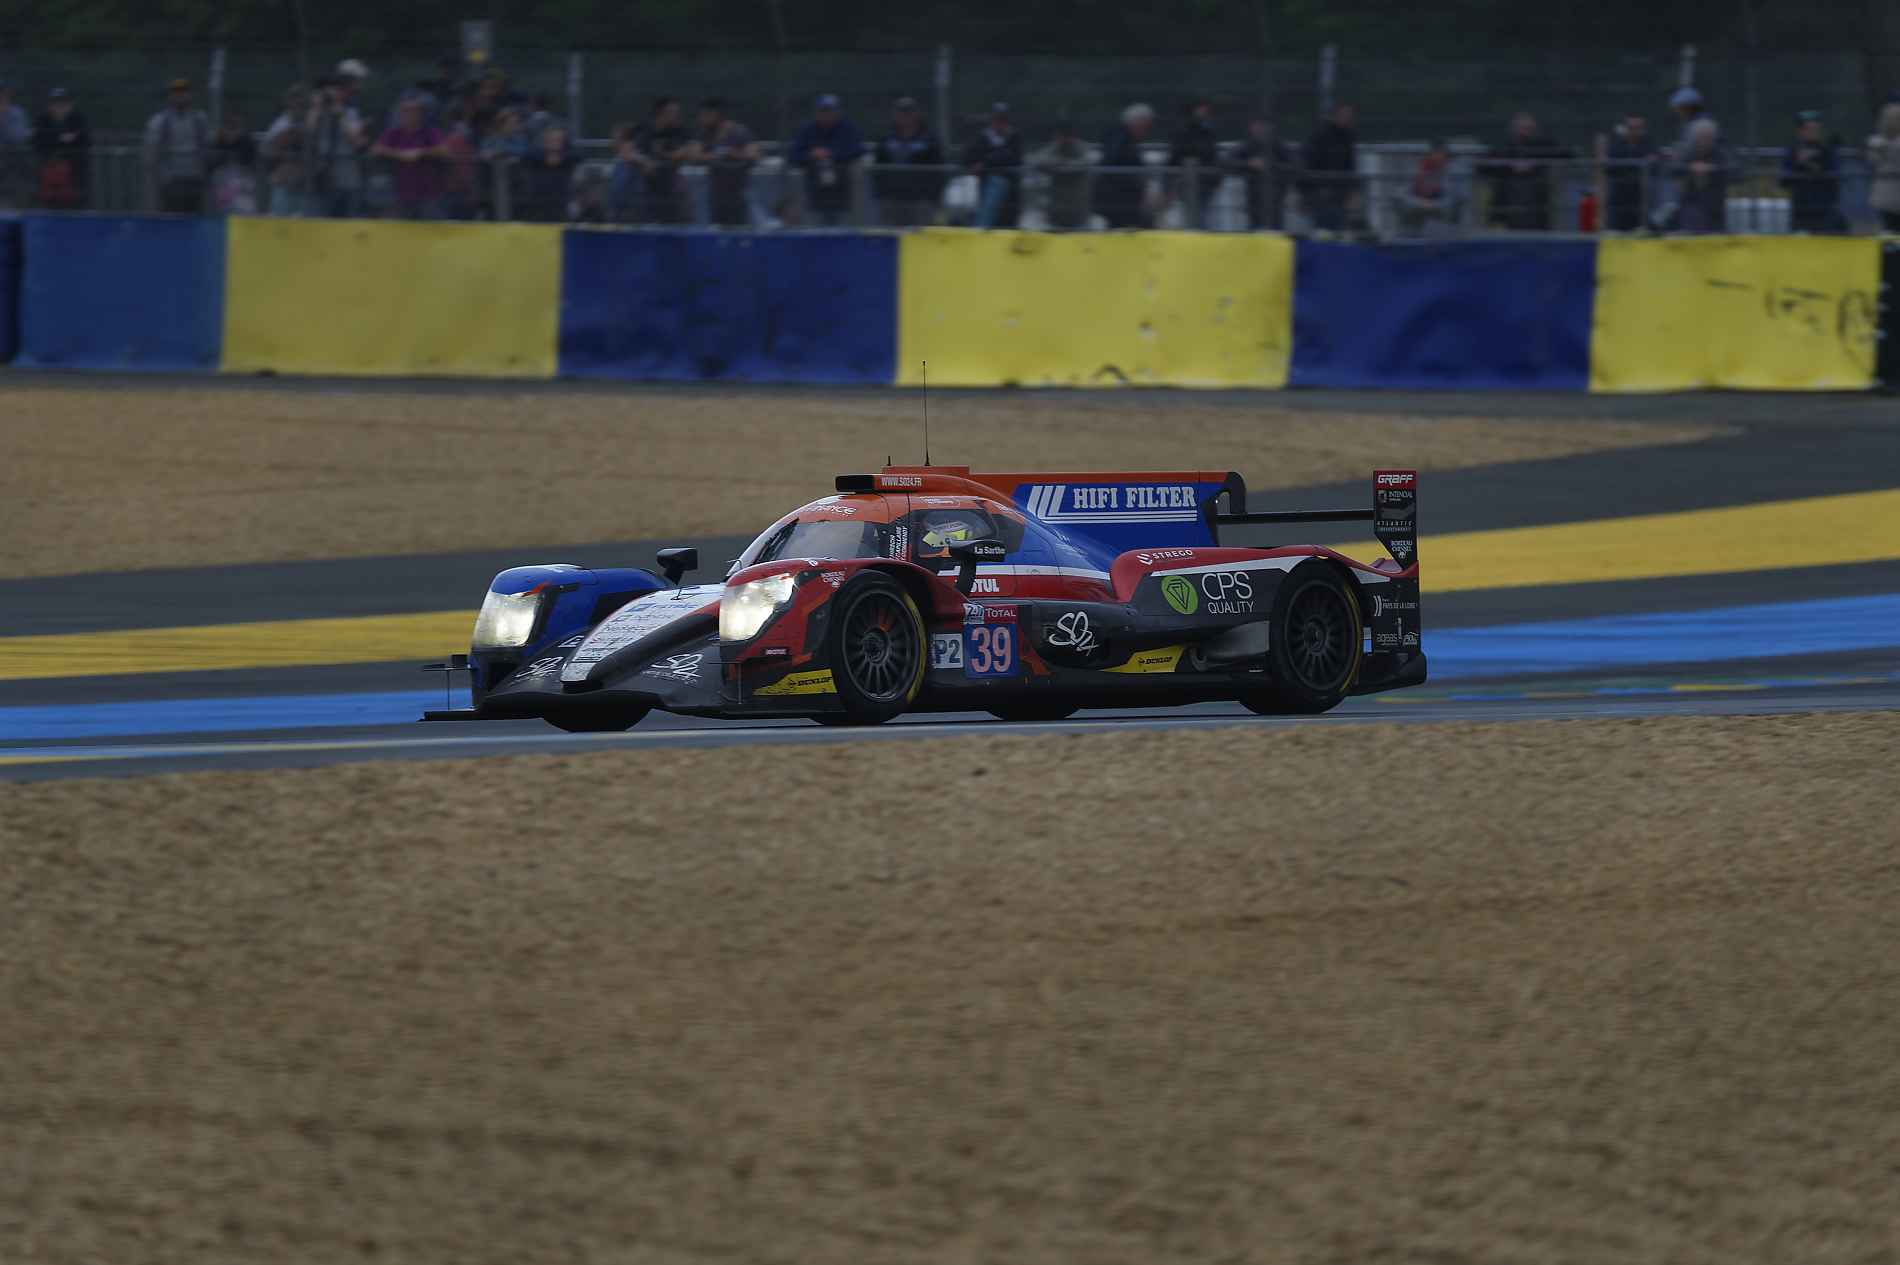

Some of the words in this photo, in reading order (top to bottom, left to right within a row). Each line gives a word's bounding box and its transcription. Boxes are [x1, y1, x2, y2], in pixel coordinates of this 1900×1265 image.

[1377, 474, 1413, 486] GRAFF
[1073, 487, 1118, 509] HIFI
[1126, 486, 1197, 508] FILTER
[1152, 549, 1193, 560] STREGO
[1201, 571, 1253, 600] CPS
[986, 608, 1017, 617] TOTAL
[1207, 601, 1255, 614] QUALITY
[971, 627, 1011, 673] 39
